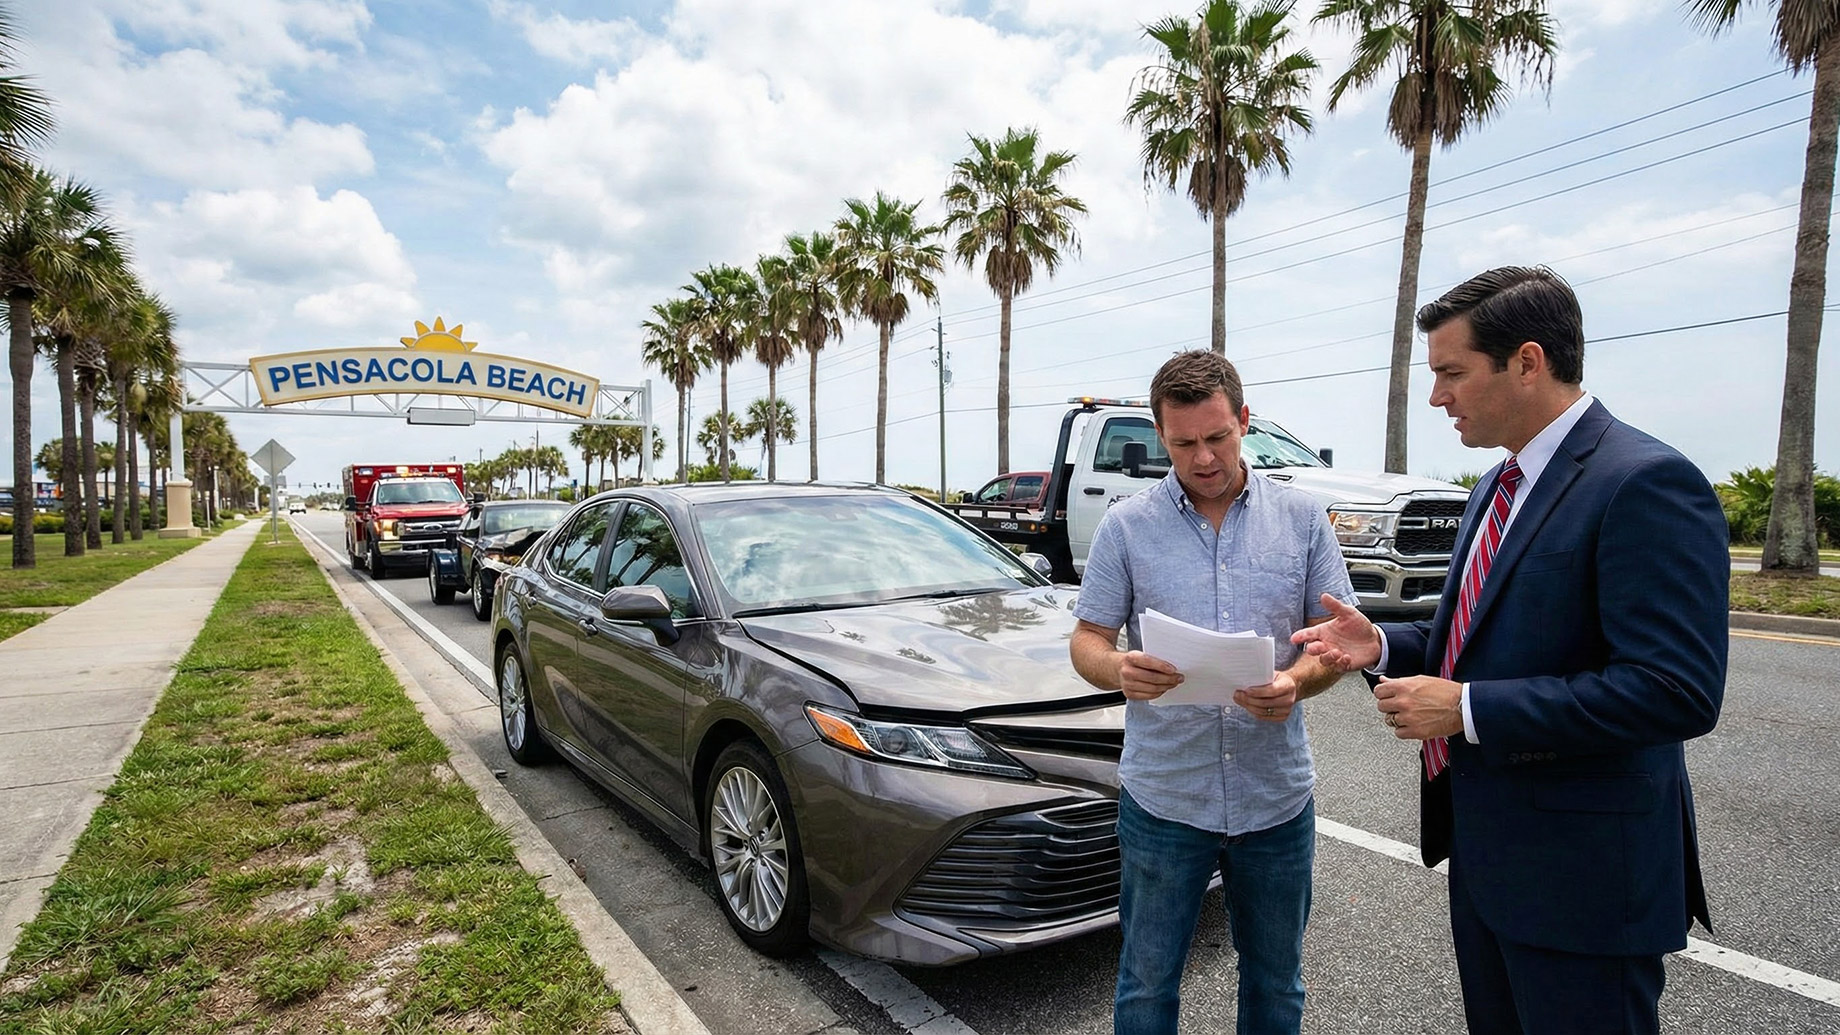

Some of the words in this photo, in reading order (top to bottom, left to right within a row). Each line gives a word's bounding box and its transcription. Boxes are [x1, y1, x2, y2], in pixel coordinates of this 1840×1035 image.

[268, 357, 477, 392] PENSACOLA
[487, 364, 586, 405] BEACH
[1431, 519, 1463, 529] RA
